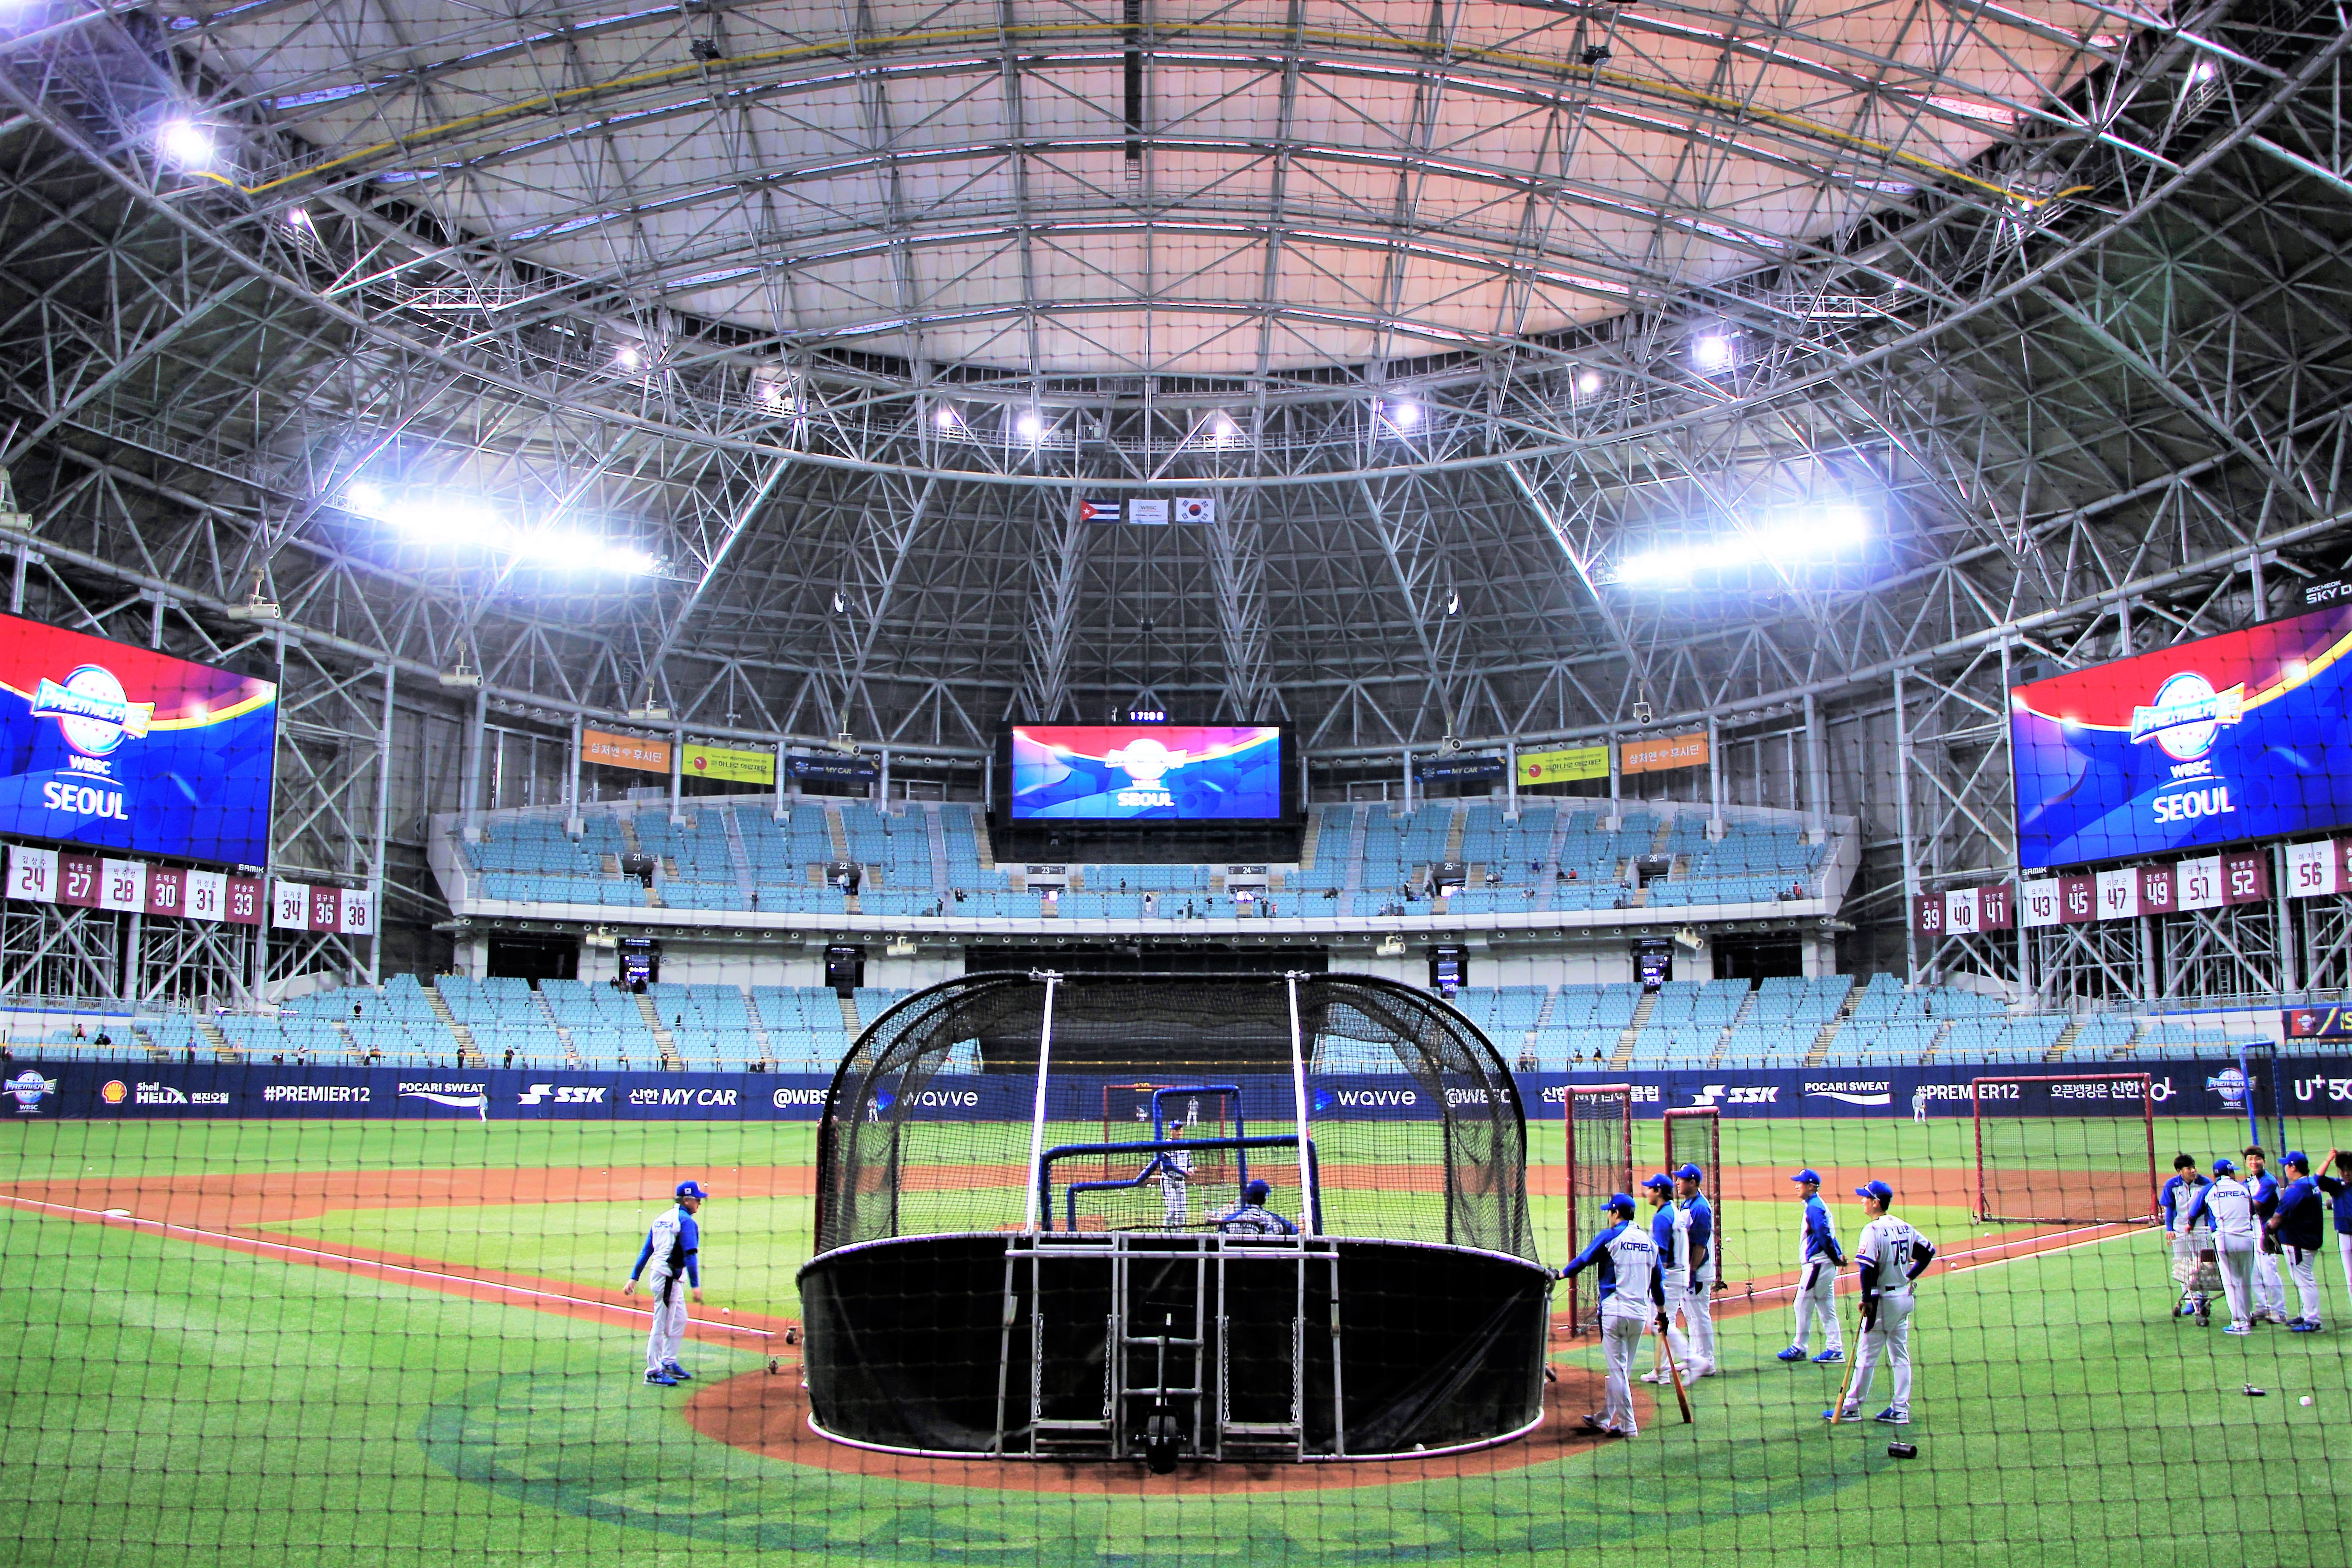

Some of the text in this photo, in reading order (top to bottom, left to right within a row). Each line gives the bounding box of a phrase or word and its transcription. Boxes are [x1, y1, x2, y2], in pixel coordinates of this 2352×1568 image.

[2306, 579, 2342, 593] GOCHEOK
[2306, 587, 2337, 604] SKY
[590, 742, 662, 763] 상처엔 후시딘
[1629, 744, 1699, 764] 상처엔 후시딘
[69, 754, 112, 775] WBSC
[2170, 759, 2212, 779] WBSC
[44, 781, 129, 821] SEOUL
[1117, 792, 1175, 807] SEOUL
[2152, 786, 2235, 824] SEOUL
[22, 855, 47, 866] 김상수
[2298, 851, 2322, 861] 이지영
[69, 862, 93, 873] 박동원
[114, 868, 136, 878] 박주성
[238, 863, 264, 873] SAMIK
[2021, 866, 2047, 876] SAMIK
[2146, 872, 2168, 882] 김선기
[2299, 861, 2322, 887] 56
[22, 866, 46, 892] 24
[68, 872, 92, 898] 27
[235, 884, 255, 893] 이승호
[2106, 878, 2127, 887] 이보근
[2190, 876, 2209, 901] 51
[2231, 869, 2255, 895] 52
[114, 878, 134, 902] 28
[155, 883, 176, 908] 30
[197, 888, 214, 911] 31
[2108, 887, 2126, 910] 47
[2146, 882, 2168, 906] 49
[234, 893, 253, 916] 33
[283, 899, 300, 921] 34
[1986, 901, 2004, 923] 41
[2033, 896, 2050, 917] 43
[2068, 890, 2088, 915] 45
[316, 902, 334, 925] 36
[349, 906, 365, 926] 38
[1922, 908, 1940, 930] 39
[1954, 905, 1970, 926] 40
[6, 1082, 43, 1090] PREMIER
[136, 1082, 159, 1091] Shell
[264, 1085, 371, 1102] #PREMIER12
[399, 1083, 485, 1093] POCARI SWEAT
[554, 1087, 607, 1104] SSK
[1630, 1085, 1659, 1103] 클럽
[1727, 1086, 1779, 1103] SSK
[1805, 1081, 1890, 1092] POCARI SWEAT
[1915, 1084, 2020, 1100] #PREMER12
[2050, 1083, 2108, 1098] 오픈뱅킹은
[2110, 1081, 2139, 1099] 신한
[135, 1091, 188, 1104] HELIX
[191, 1092, 230, 1104] 엔진오일
[629, 1088, 738, 1106] 신한 MY CAR
[773, 1088, 840, 1108] @WBS
[1337, 1089, 1417, 1106] wavve
[1445, 1088, 1511, 1108] @WBC
[1620, 1241, 1654, 1252] KOREA
[1891, 1238, 1908, 1266] 75
